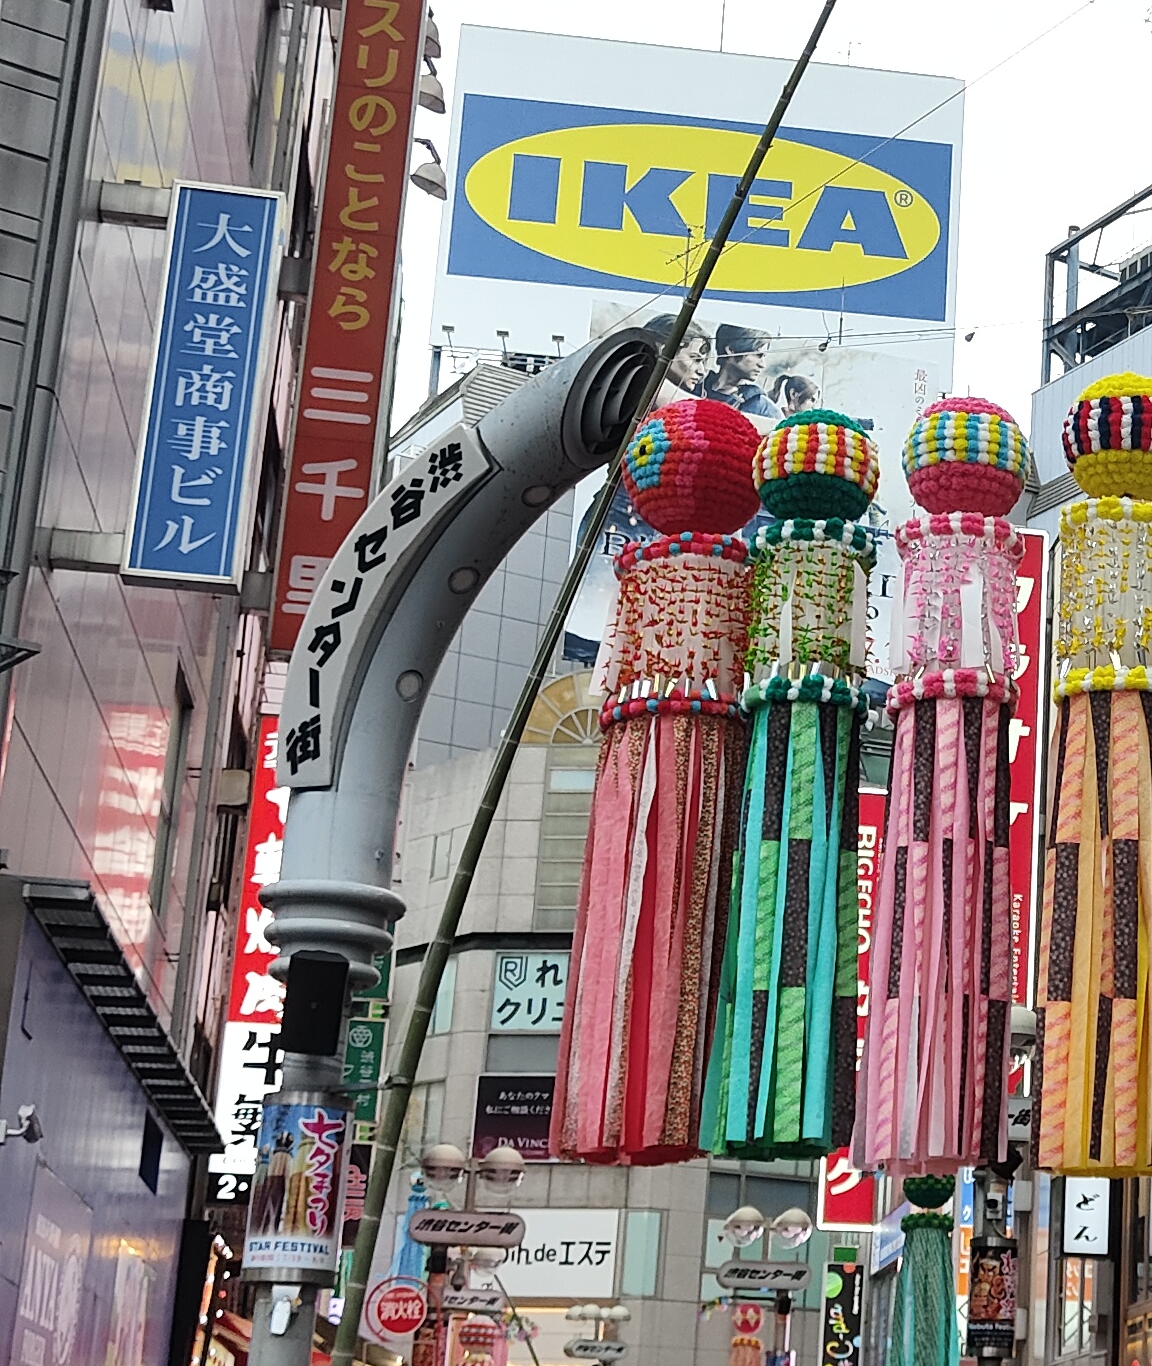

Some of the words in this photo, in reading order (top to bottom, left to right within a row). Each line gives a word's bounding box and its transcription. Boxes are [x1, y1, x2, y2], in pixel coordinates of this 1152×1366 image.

[507, 153, 909, 261] IKEA
[152, 212, 255, 556] 大盛堂商事ビル
[286, 442, 464, 776] 渋谷センター街
[300, 1108, 345, 1237] 七夕まつり
[249, 1240, 271, 1252] STAR
[274, 1241, 330, 1256] FESTIVAL
[559, 1241, 612, 1266] エステ
[1073, 1191, 1100, 1243] どん
[380, 1299, 423, 1322] 消火栓
